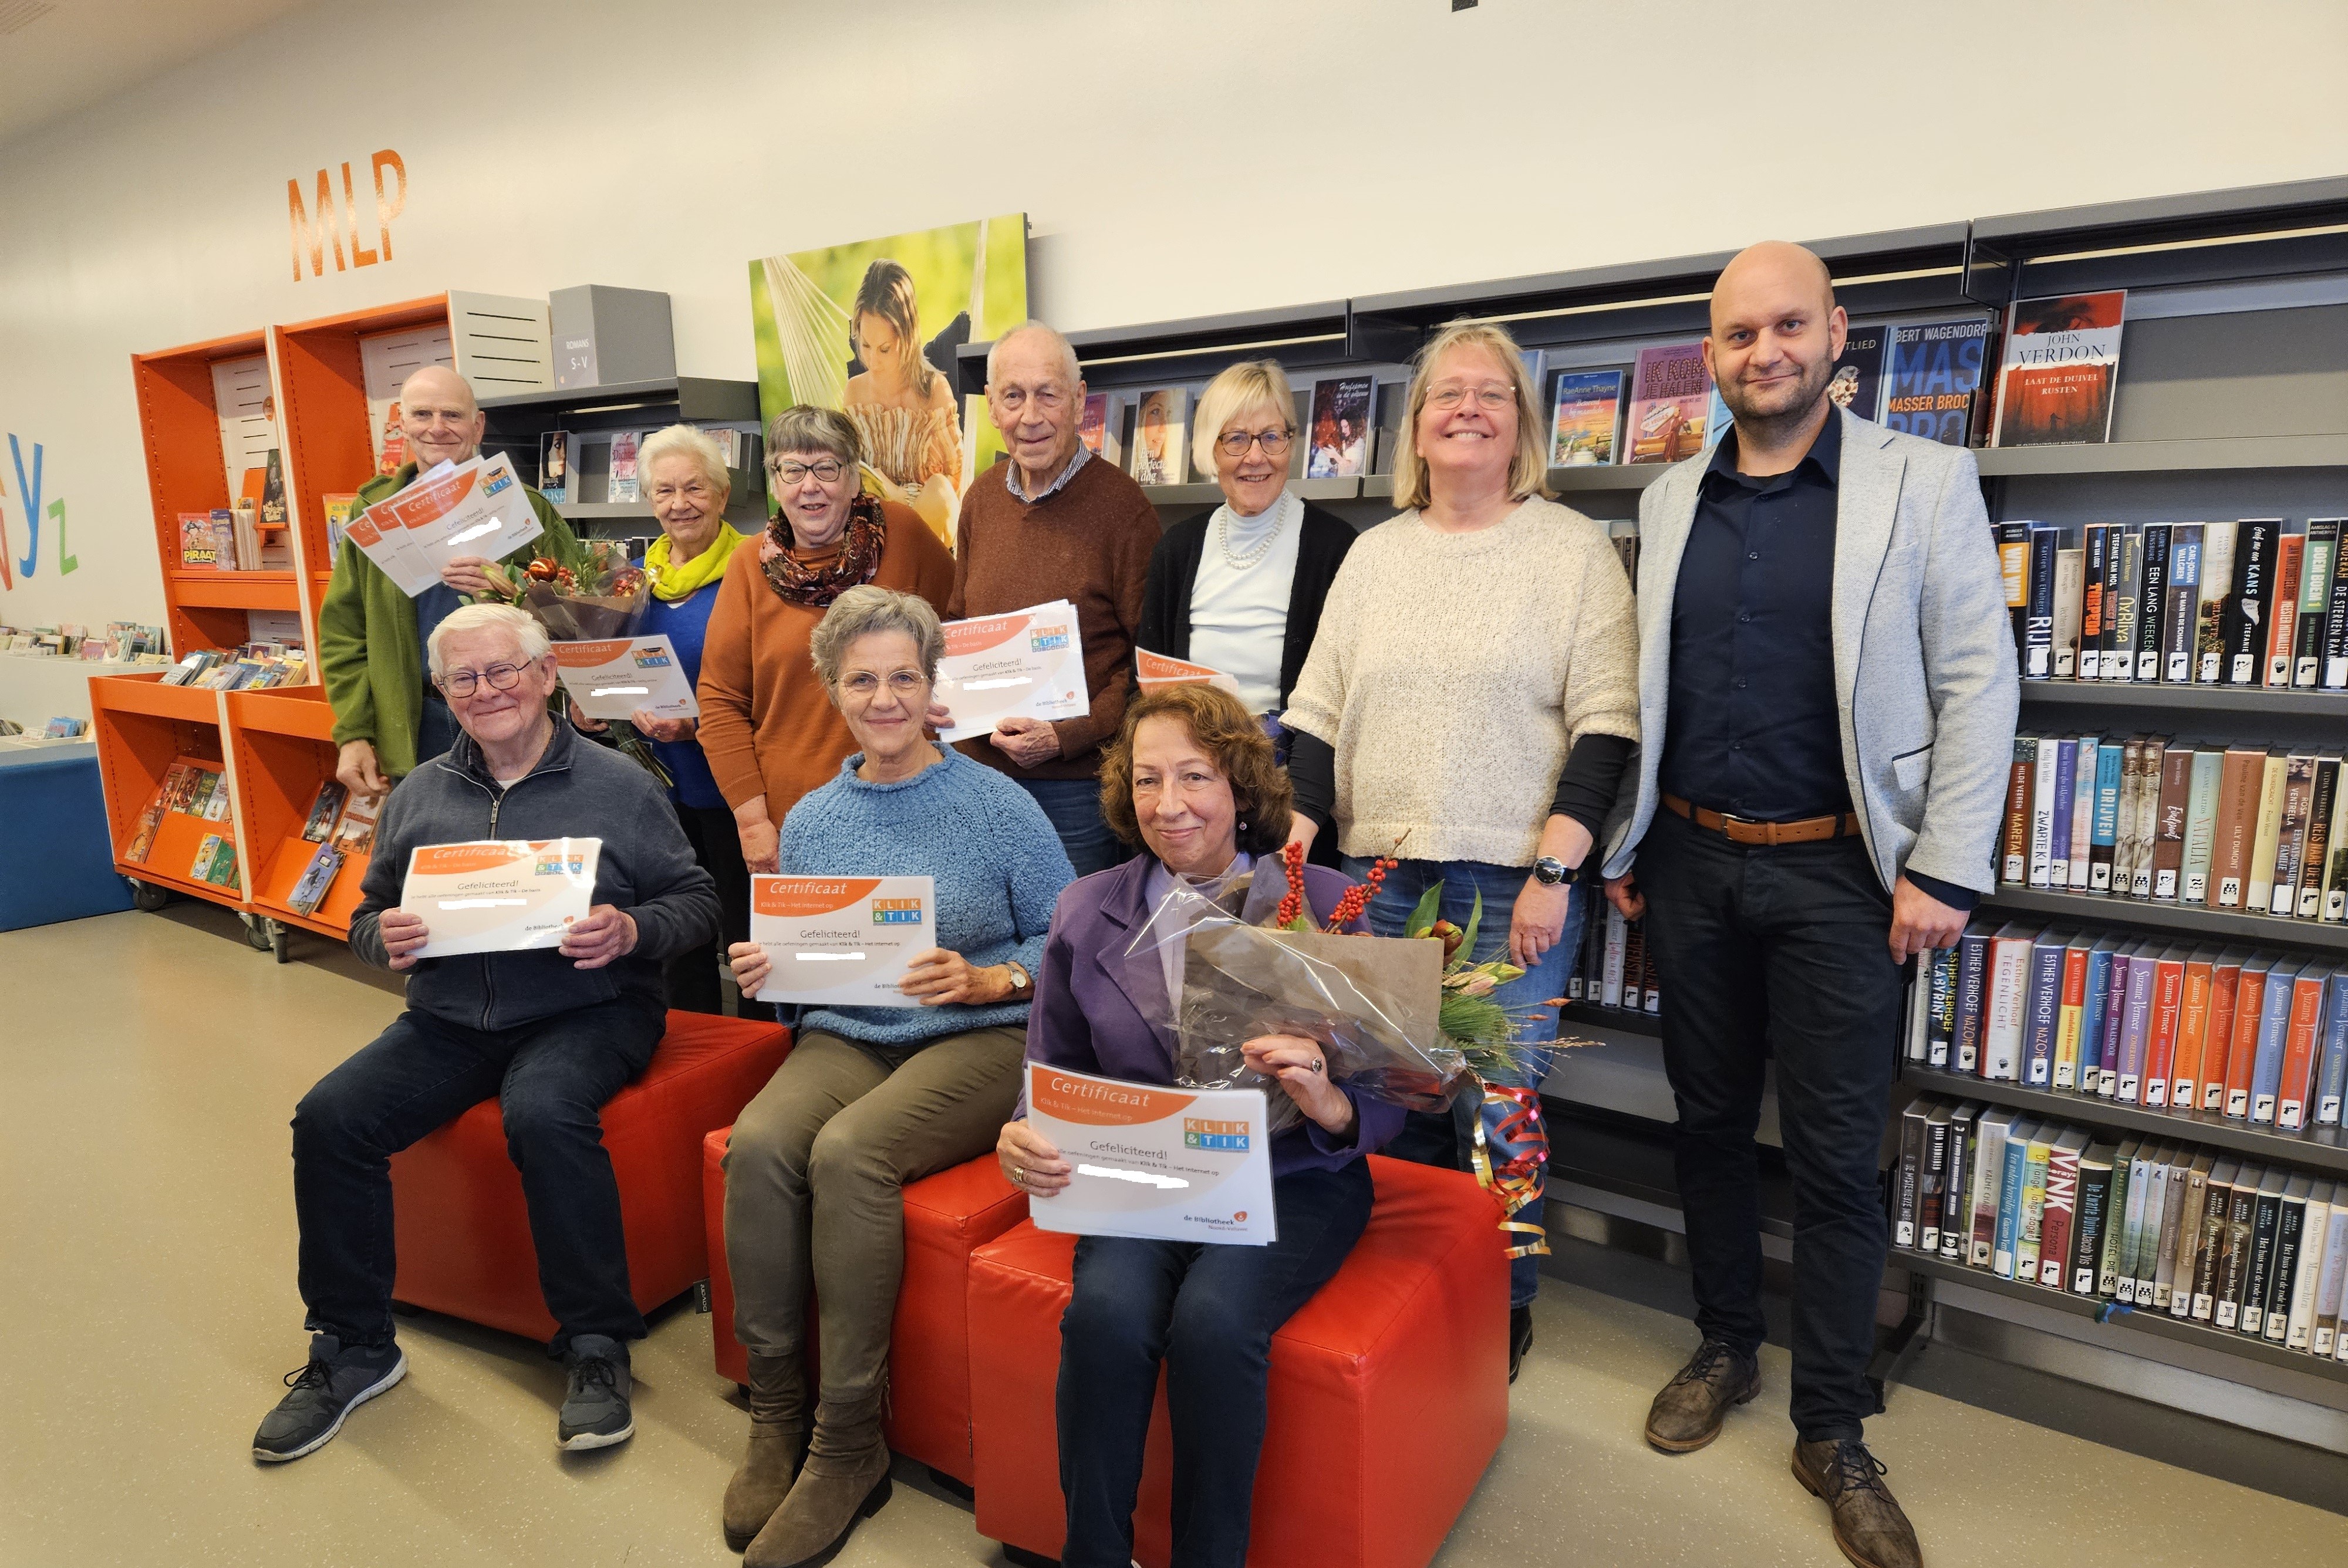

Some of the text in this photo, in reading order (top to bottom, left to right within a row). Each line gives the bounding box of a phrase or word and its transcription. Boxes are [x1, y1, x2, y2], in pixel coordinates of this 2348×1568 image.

[288, 148, 407, 282] MLP
[566, 339, 589, 350] ROMANS
[1896, 328, 1920, 343] BERT
[2047, 333, 2080, 347] JOHN
[2019, 344, 2107, 364] VERDON
[1645, 357, 1705, 383] IK KOM
[2025, 377, 2046, 386] LAAT
[2064, 374, 2099, 383] DUIVEL
[1563, 384, 1616, 394] RaeAnne Thayne
[1642, 384, 1658, 400] JE
[2041, 386, 2078, 395] RUSTEN
[1888, 393, 1969, 412] MASSER BROC
[1136, 458, 1167, 474] perfecte
[1141, 470, 1157, 484] dag
[408, 480, 461, 512] Certificaat
[491, 477, 510, 490] TIK
[2111, 533, 2120, 559] STEFANIE
[2148, 530, 2157, 561] RENSBURG
[2157, 530, 2165, 548] LAURE
[2005, 546, 2023, 573] WIN
[2110, 561, 2118, 573] VAN
[2176, 548, 2187, 579] VALLGREN
[2187, 545, 2197, 583] CARL-JOHAN
[2312, 546, 2328, 573] BOEM
[2003, 575, 2021, 601] WIN
[2109, 574, 2117, 586] MOL
[2245, 565, 2261, 594] KANS
[2309, 575, 2324, 600] BOEM
[2085, 583, 2103, 636] TORPEDO
[2144, 567, 2160, 651] EEN LANG WEEKEN
[944, 620, 1008, 638] Certificaat
[1031, 626, 1066, 638] KLIK
[1043, 635, 1067, 645] TIK
[2242, 623, 2252, 653] STEFANIE
[559, 644, 612, 654] Certificaat
[592, 673, 633, 681] Gefeliciteerd!
[973, 658, 1021, 671] Gefeliciteerd!
[2015, 766, 2026, 809] HILDE VEEREN
[2098, 788, 2116, 836] DRIJVEN
[2286, 788, 2299, 825] VENTRELLA
[2299, 797, 2309, 816] ROSA
[2036, 810, 2049, 849] ZWARTE
[2190, 818, 2211, 865] NATALIA
[2229, 826, 2242, 869] LILY DUMONT
[2278, 844, 2290, 870] FAMILIE
[2307, 823, 2326, 877] REIS NAAR DE
[458, 880, 519, 890] Gefeliciteerd!
[770, 882, 848, 894] Certificaat
[874, 900, 919, 909] KLIK
[875, 912, 919, 921] & TIK
[801, 930, 860, 938] Gefeliciteerd!
[1964, 944, 1983, 1012] ESTHER VERHOEF
[1931, 964, 1948, 1020] LABYRINT
[1943, 952, 1959, 1032] ESTHER VERHOEF
[1997, 954, 2013, 1031] TEGENLICHT
[2010, 958, 2025, 1028] Esther Verhoef
[2108, 964, 2127, 1056] Suzanne Vermeer DWAALSPOOR
[2127, 968, 2150, 1072] Suzanne Vermeer ZOMERAVOND
[2269, 982, 2289, 1047] Suzanne Vermeer
[1041, 1097, 1052, 1106] Klik
[1051, 1077, 1150, 1107] Certificaat
[1187, 1120, 1246, 1133] KLIK
[1090, 1141, 1168, 1160] Gefeliciteerd!
[1187, 1134, 1246, 1147] & TIK
[1984, 1170, 1993, 1191] KALME
[2026, 1154, 2046, 1239] Die lange, lange dagen
[1195, 1216, 1234, 1225] Bibliotheek
[2079, 1184, 2104, 1265] De Zwarte Duivel Jacob Vis
[2048, 1220, 2064, 1256] Persona
[2109, 1234, 2118, 1256] HOTEL
